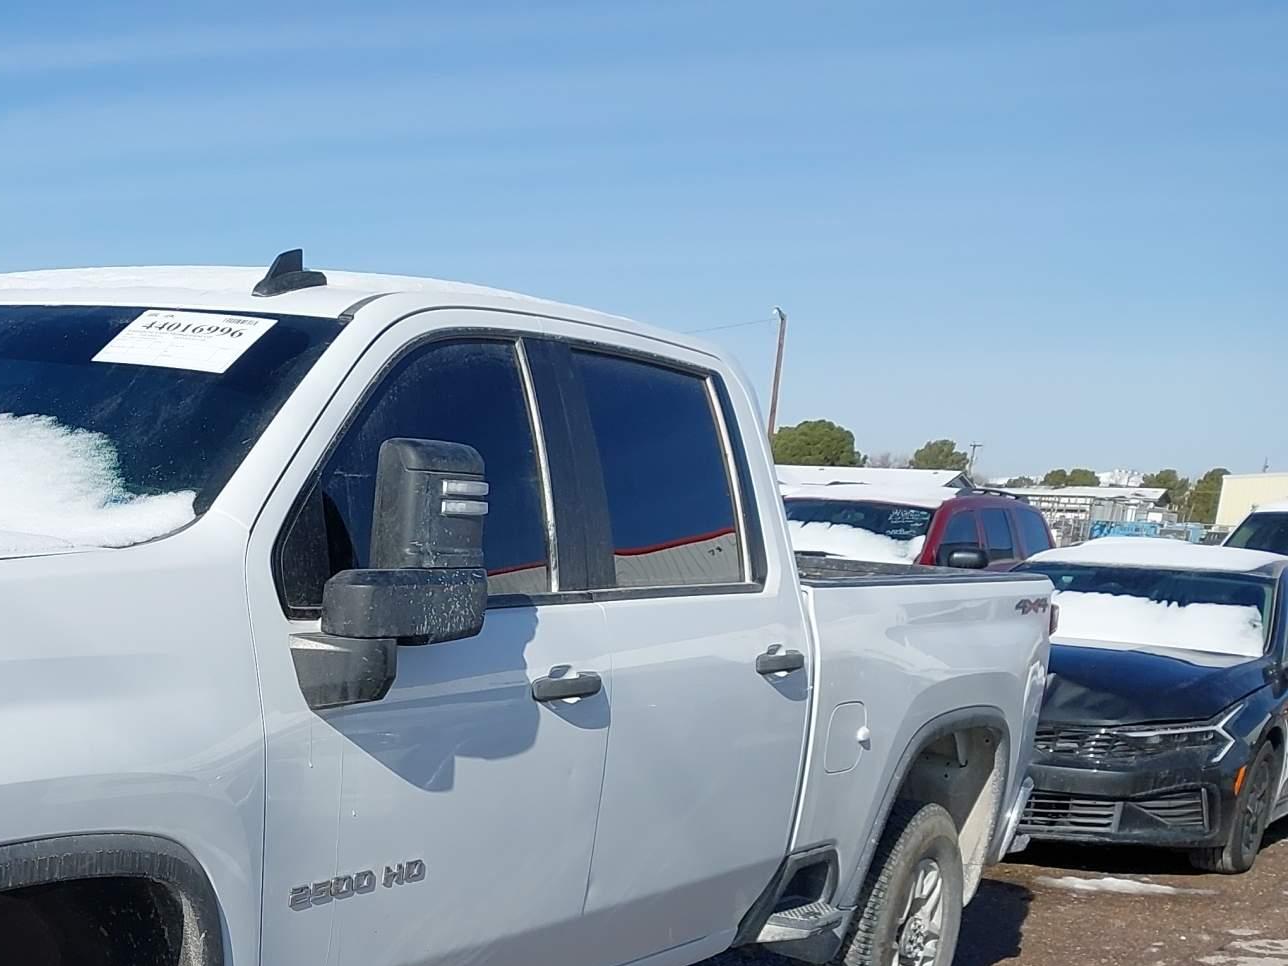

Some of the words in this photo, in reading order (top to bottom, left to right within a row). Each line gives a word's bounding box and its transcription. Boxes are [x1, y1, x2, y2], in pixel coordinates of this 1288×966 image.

[142, 320, 248, 339] 44016996
[287, 869, 377, 912] 2500
[382, 858, 428, 889] HD
